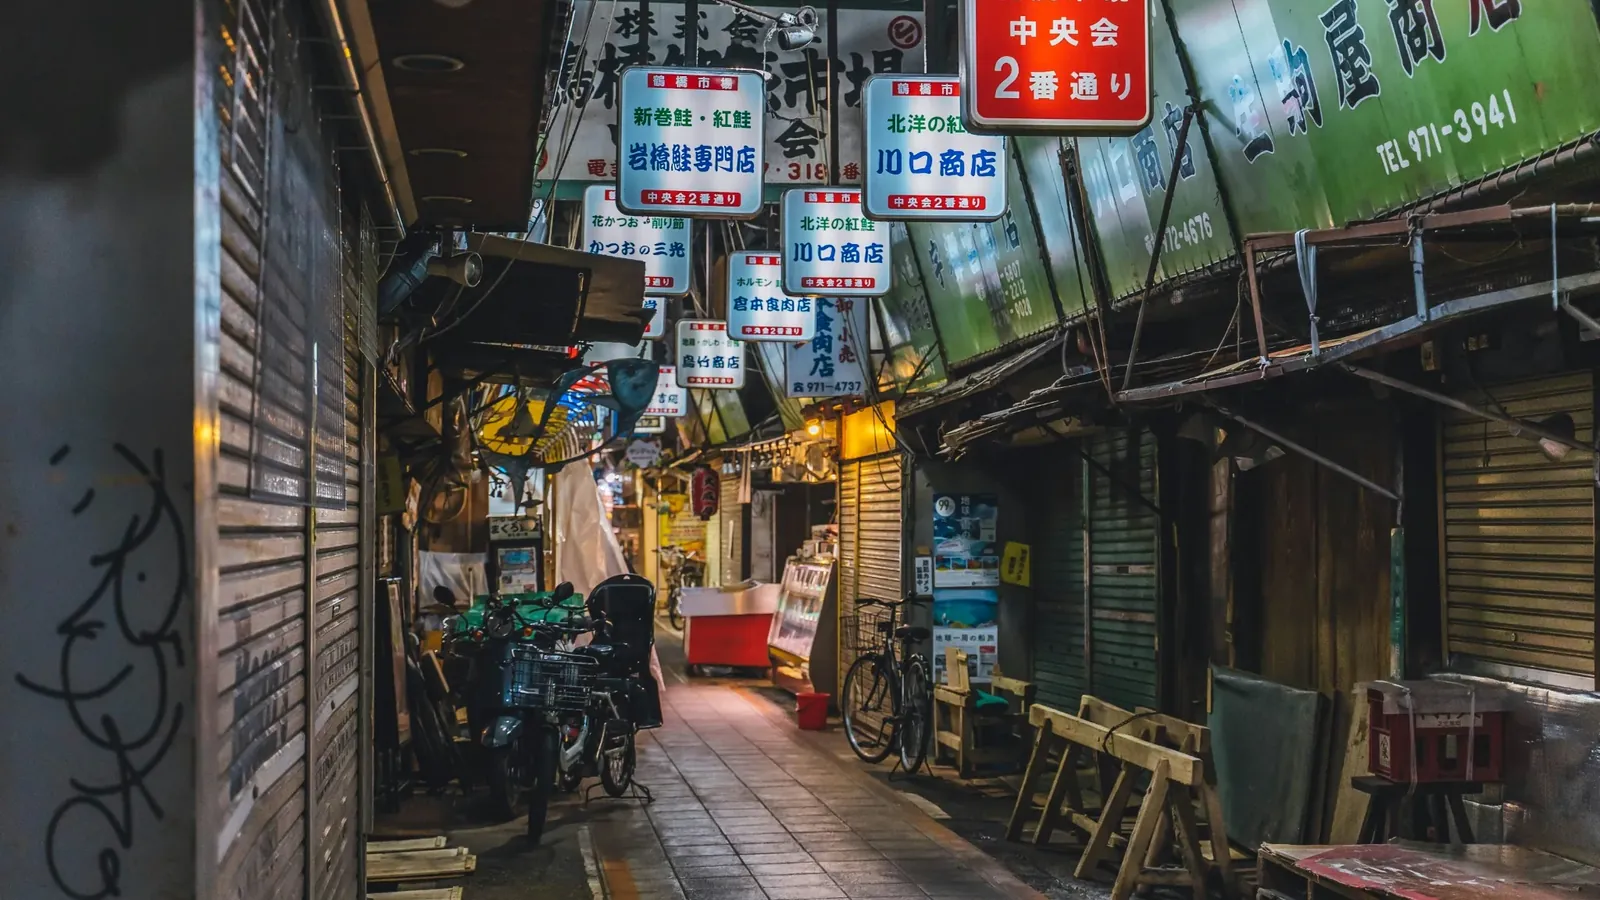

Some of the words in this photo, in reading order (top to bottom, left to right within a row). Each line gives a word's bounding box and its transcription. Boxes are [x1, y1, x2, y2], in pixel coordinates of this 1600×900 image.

[614, 8, 824, 43] 株式会
[1009, 15, 1120, 47] 中央会
[994, 56, 1131, 101] 2番通り
[633, 106, 752, 129] 新巻鮭・紅鮭
[887, 114, 972, 133] 北洋の紅
[1376, 138, 1410, 175] TEL
[1407, 89, 1517, 162] 971-3941
[627, 143, 756, 174] 岩橋鮭専門店
[876, 148, 997, 177] 川口商店
[647, 192, 736, 205] 中央会2番通り
[893, 197, 982, 209] 中央会2番通り
[800, 216, 876, 231] 北洋の紅鮭
[589, 240, 685, 258] かつおの三光
[793, 243, 884, 264] 川口商店
[805, 279, 872, 287] 中央会2番通り
[733, 296, 811, 312] 倉本食肉店
[806, 381, 862, 392] 971-4737
